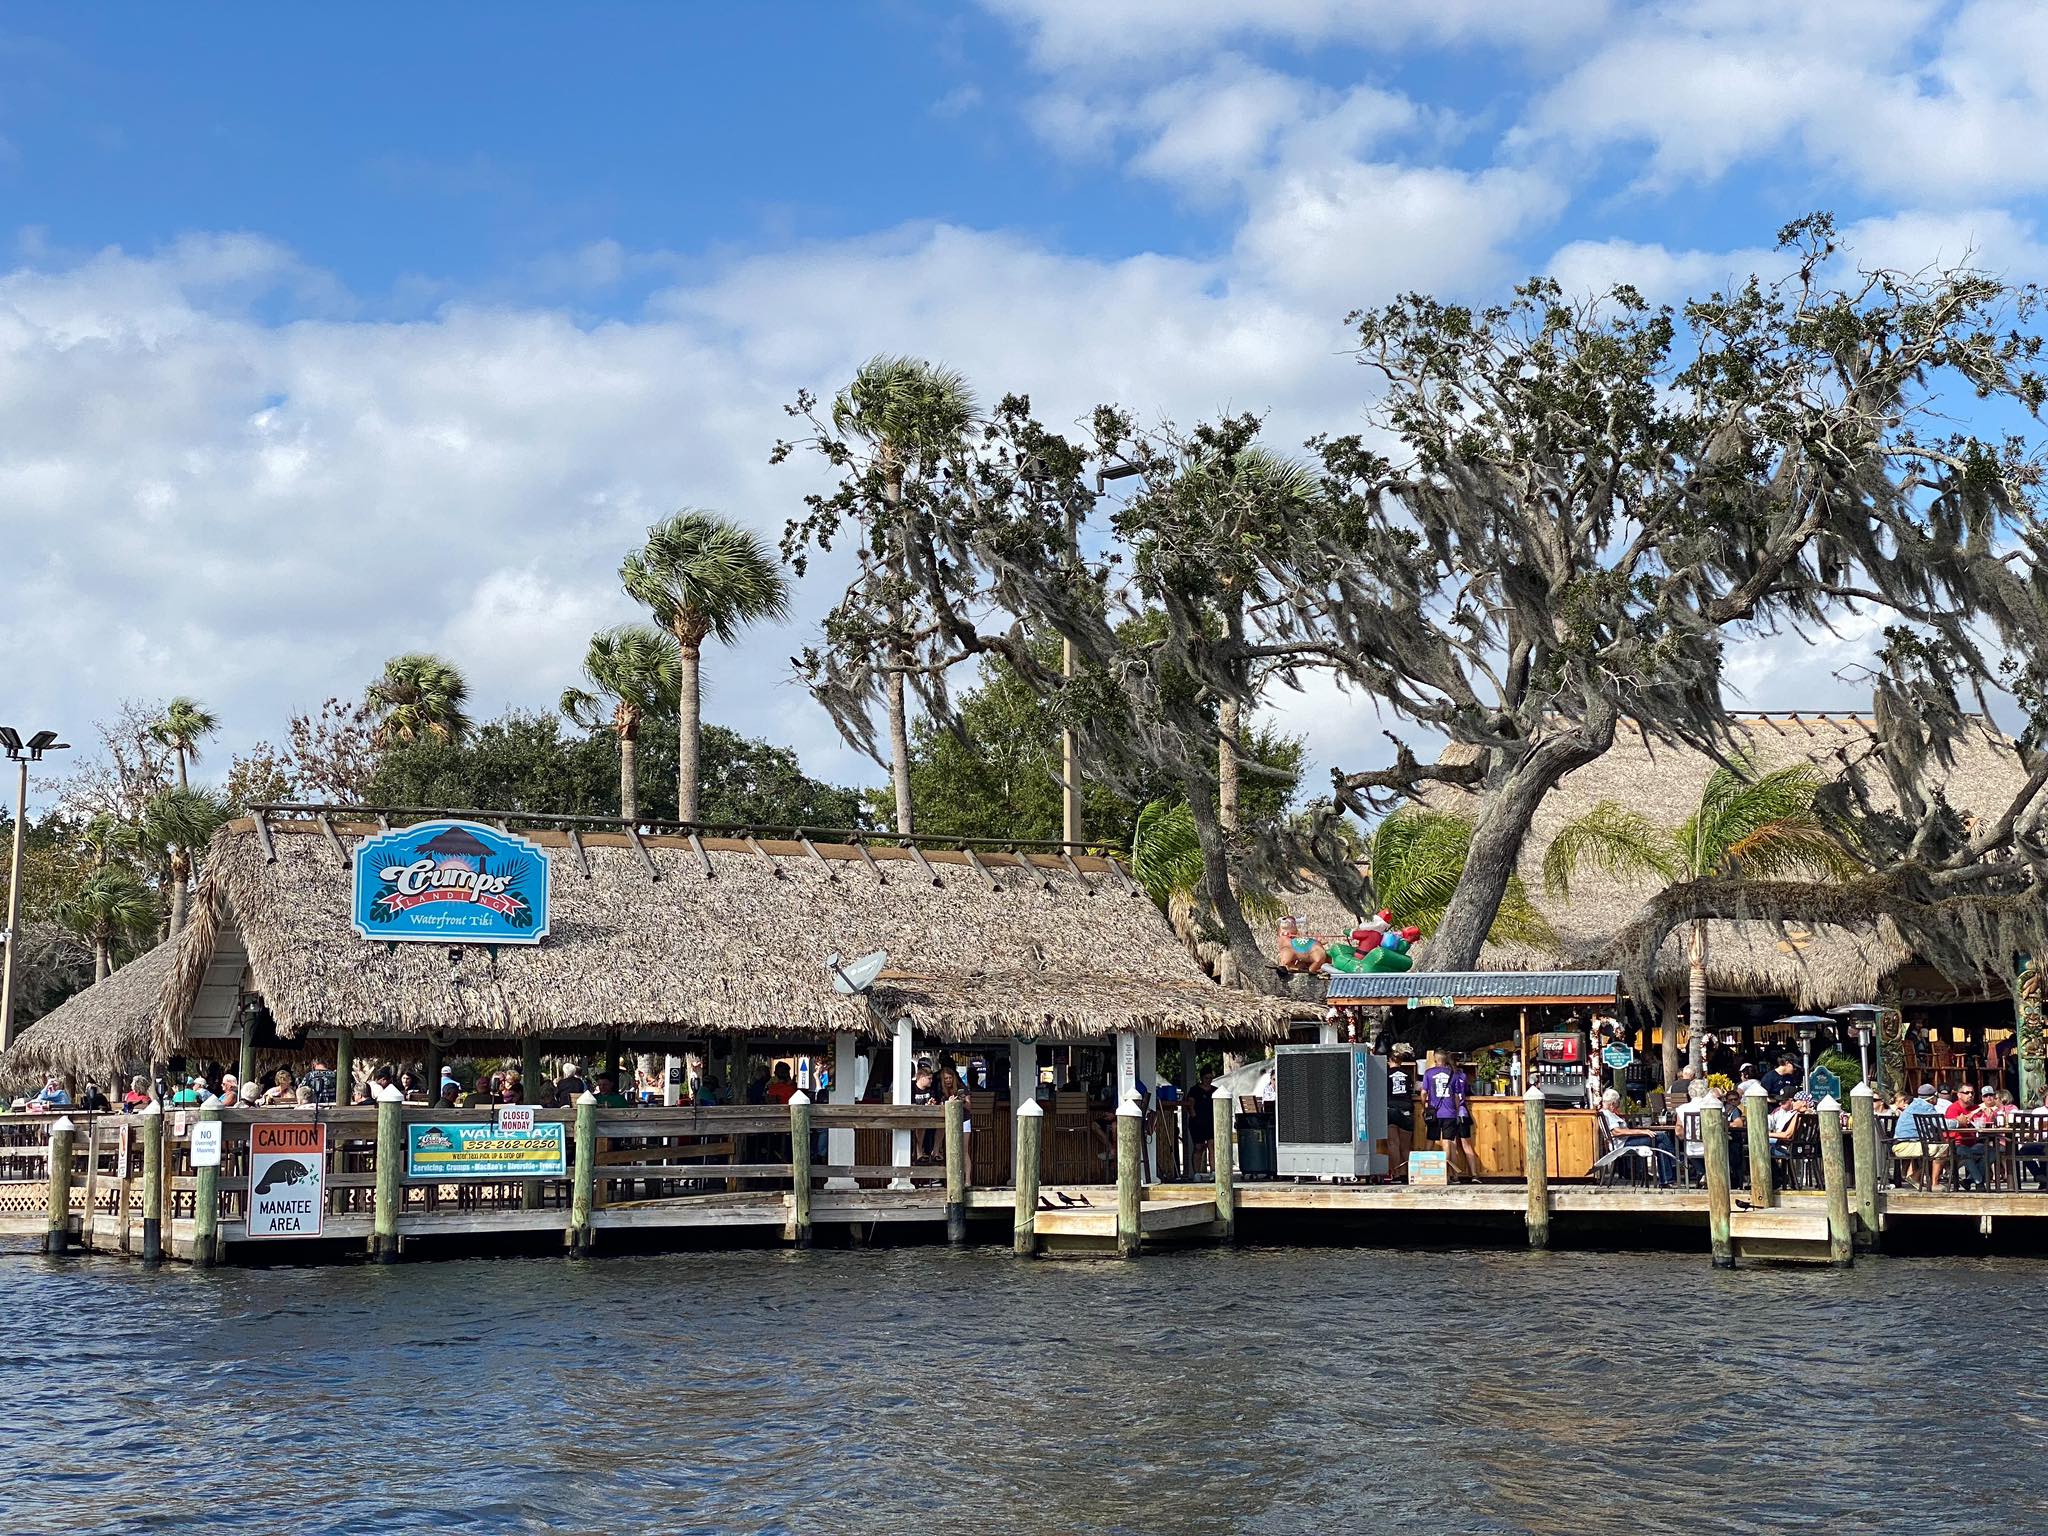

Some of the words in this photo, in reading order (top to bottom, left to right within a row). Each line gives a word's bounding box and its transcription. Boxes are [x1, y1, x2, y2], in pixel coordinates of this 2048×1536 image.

[379, 859, 512, 903] Crumps
[406, 892, 501, 909] LANDING
[410, 912, 467, 929] Waterfront
[469, 914, 493, 926] Tiki
[503, 1111, 530, 1120] CLOSED
[501, 1121, 531, 1131] MONDAY
[200, 1131, 212, 1139] NO
[258, 1130, 318, 1147] CAUTION
[459, 1129, 517, 1139] WATER
[526, 1128, 559, 1138] TAXI
[467, 1140, 556, 1150] 352-262-0250
[259, 1200, 311, 1214] MANATEE
[269, 1218, 301, 1231] AREA
